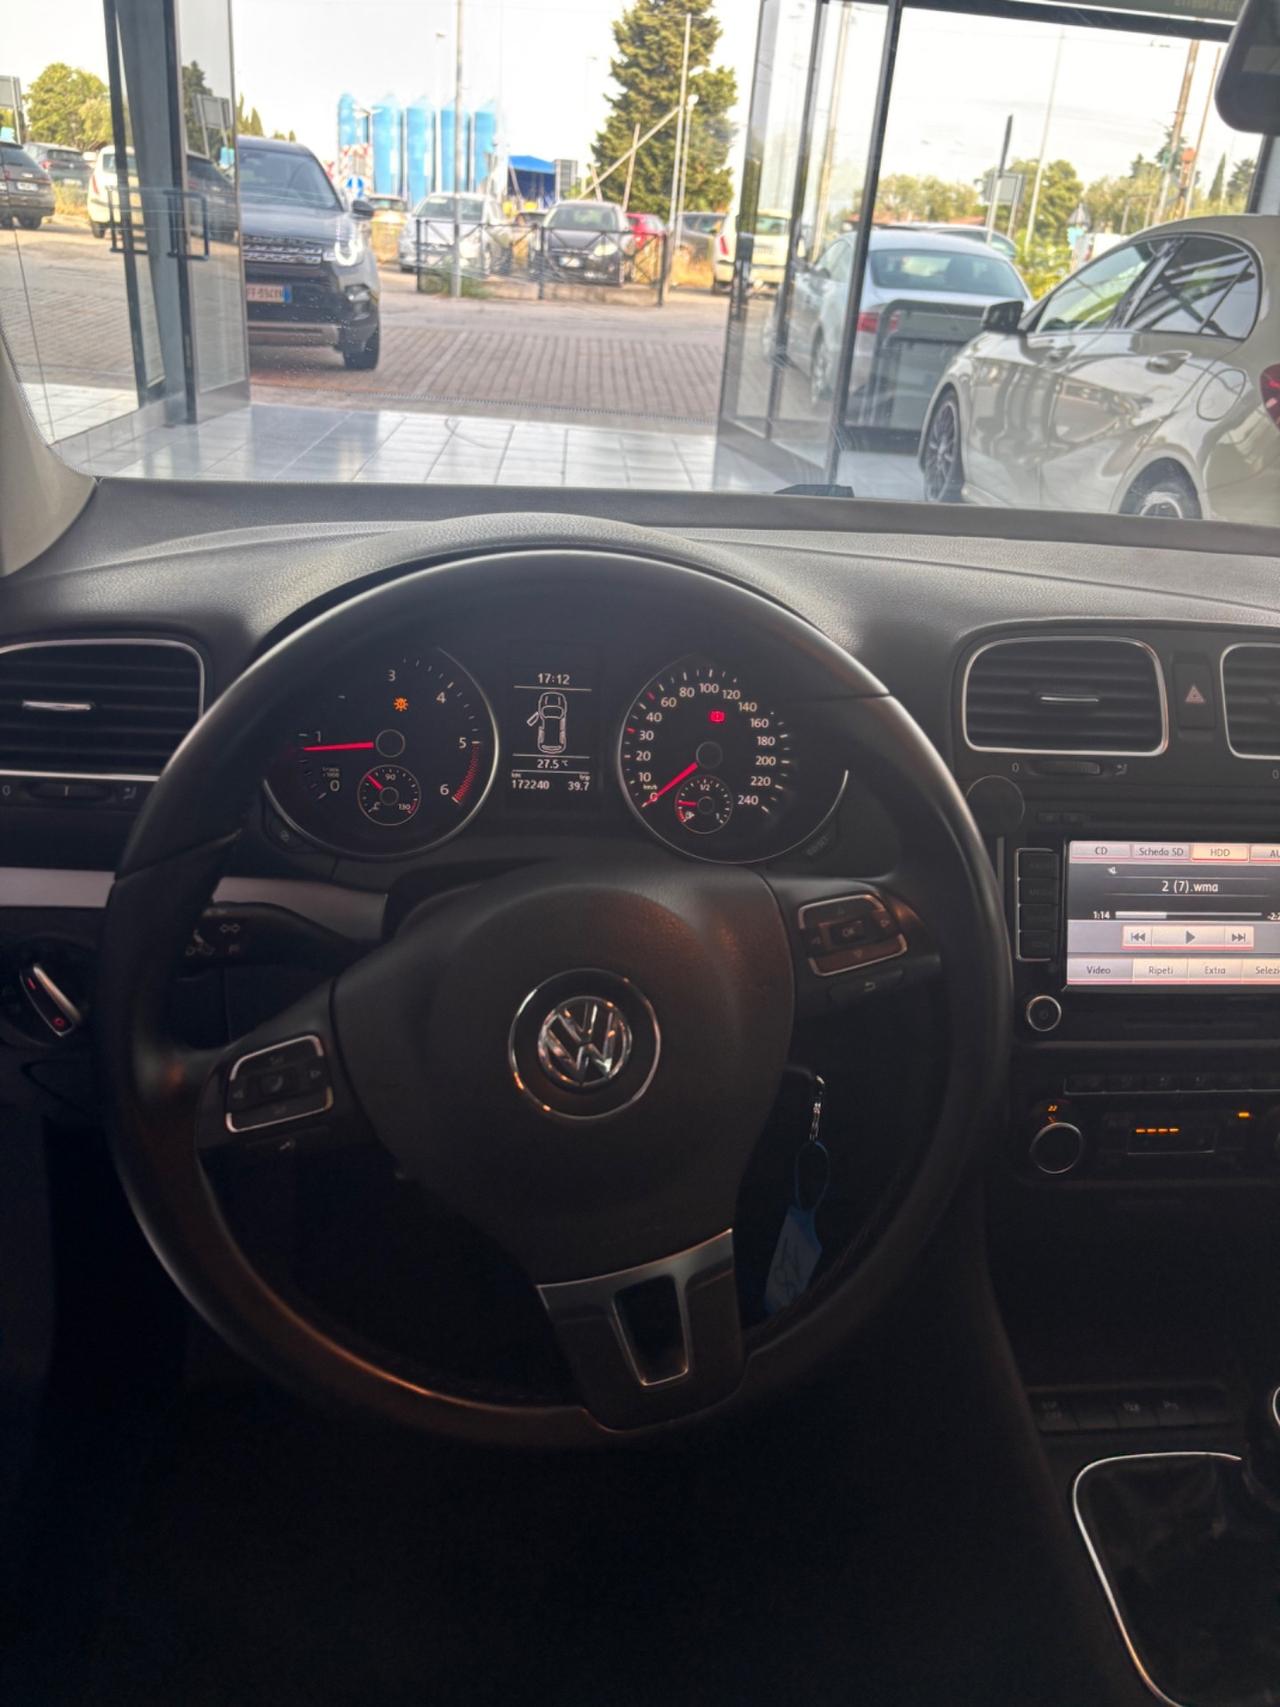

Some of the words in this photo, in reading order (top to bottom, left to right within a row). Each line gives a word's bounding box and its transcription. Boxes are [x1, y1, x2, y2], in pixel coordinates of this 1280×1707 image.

[388, 669, 396, 682] 3
[538, 673, 570, 685] 17:12
[679, 687, 695, 698] 80
[699, 683, 719, 694] 100
[436, 691, 446, 704] 4
[722, 689, 741, 700] 120
[660, 697, 677, 708] 60
[738, 702, 757, 713] 140
[646, 712, 662, 723] 40
[750, 718, 769, 728] 160
[639, 730, 654, 741] 30
[458, 737, 467, 749] 5
[756, 736, 775, 747] 180
[636, 750, 651, 761] 20
[536, 759, 560, 769] 27.5
[755, 756, 776, 767] 200
[639, 772, 652, 782] 10
[750, 776, 771, 787] 220
[329, 779, 340, 792] 0
[439, 784, 449, 796] 6
[512, 780, 550, 790] 172240
[567, 781, 590, 791] 39.7
[738, 794, 759, 805] 240
[1095, 846, 1108, 855] CD
[1171, 847, 1184, 857] SD
[1210, 848, 1231, 857] HDD
[1161, 881, 1169, 893] 2
[1173, 880, 1219, 894] (7).wma
[1093, 911, 1110, 920] 1:14
[1086, 965, 1111, 975] Video
[1148, 965, 1174, 976] Ripeti
[1204, 966, 1226, 975] Extra
